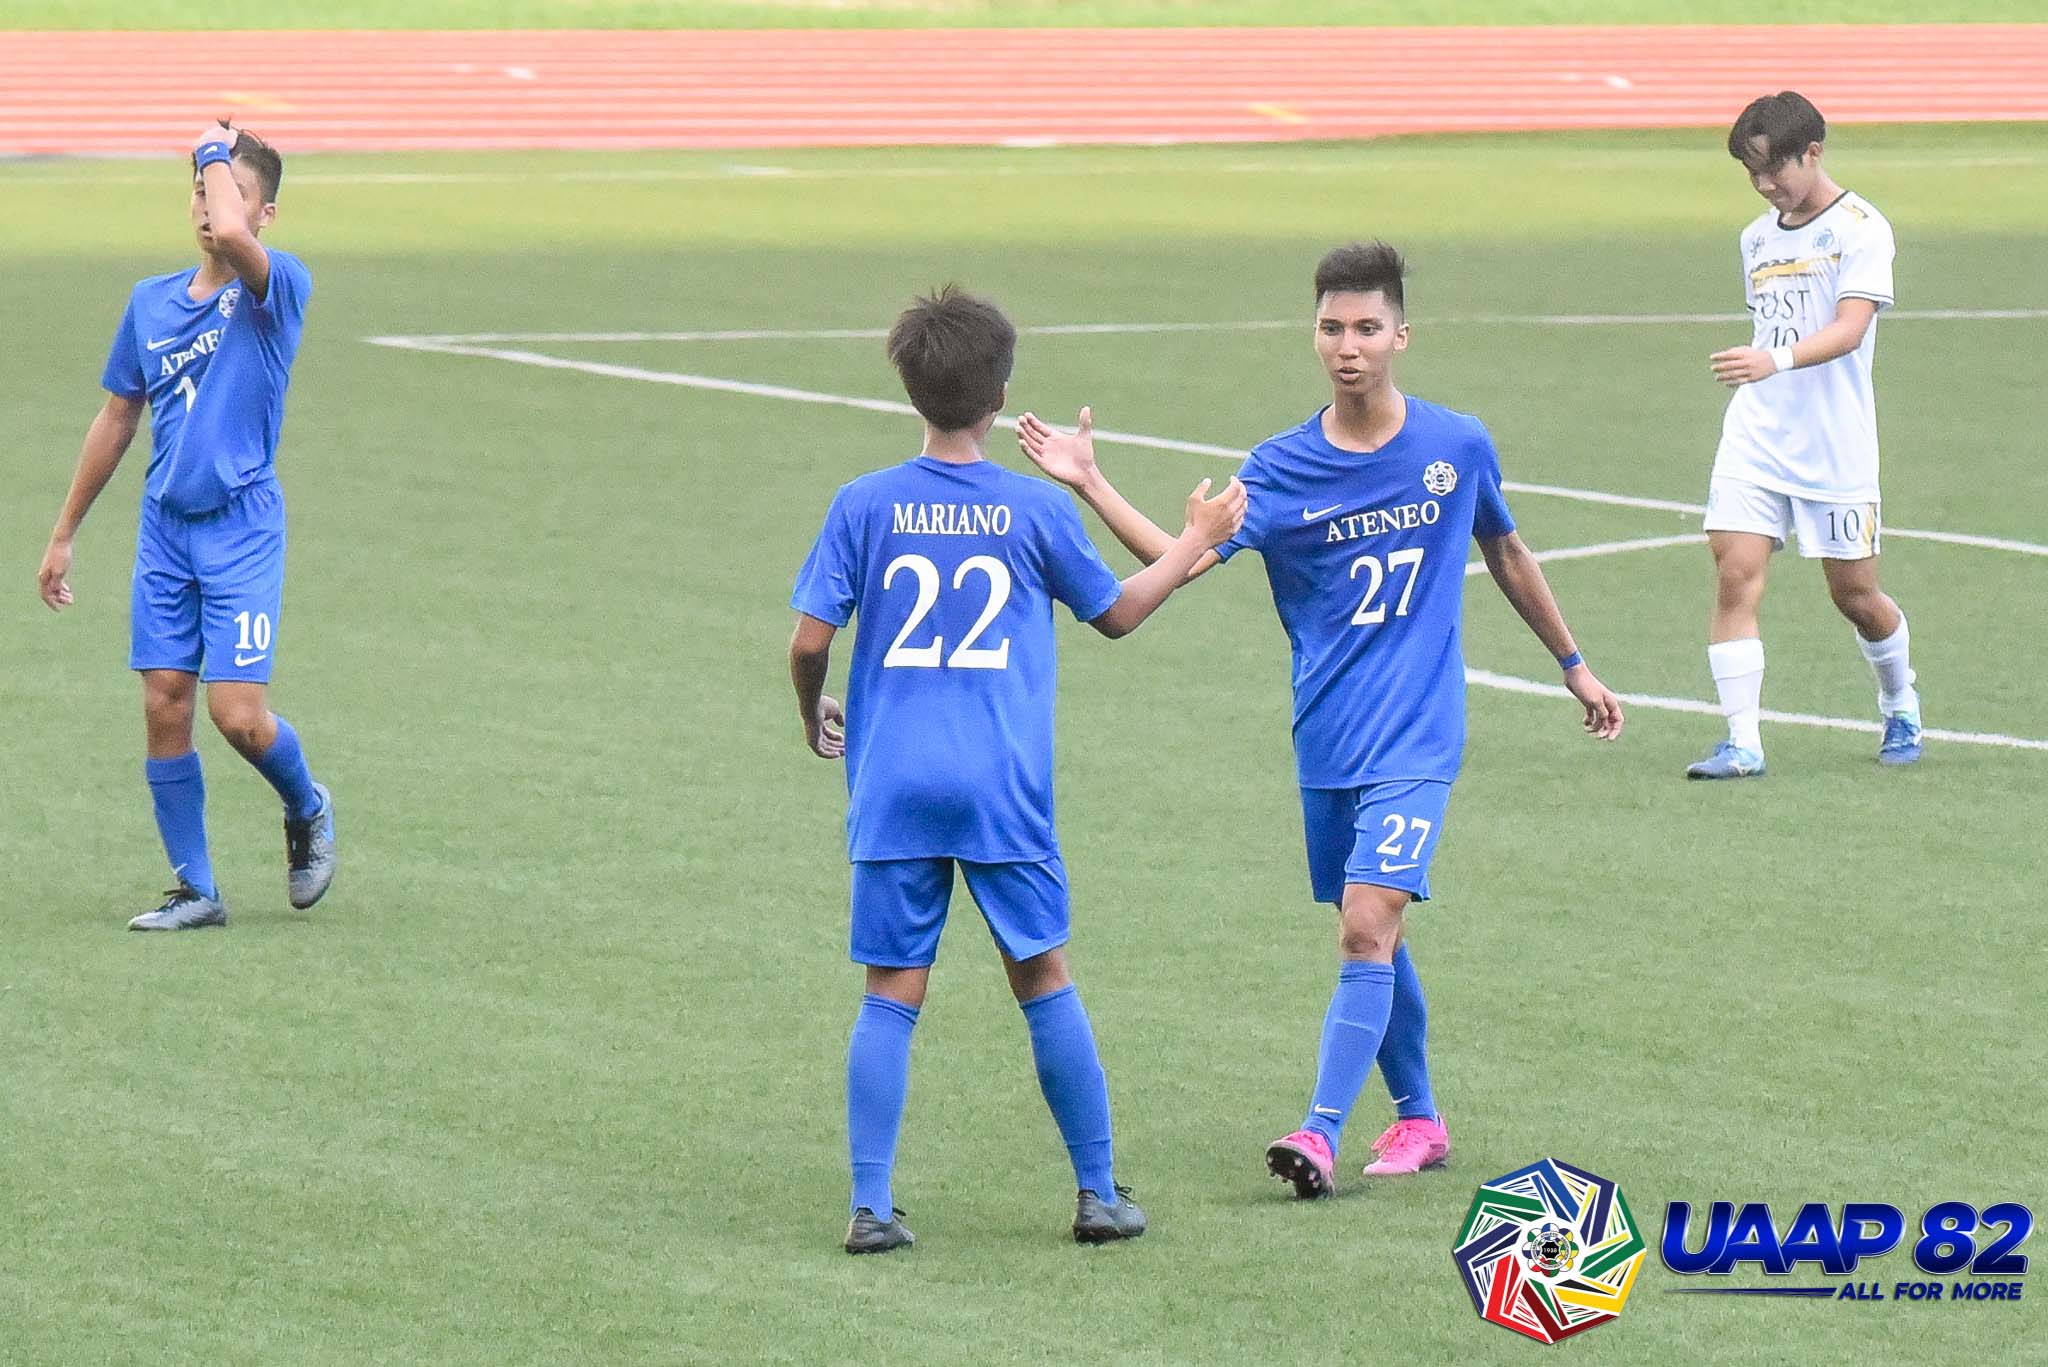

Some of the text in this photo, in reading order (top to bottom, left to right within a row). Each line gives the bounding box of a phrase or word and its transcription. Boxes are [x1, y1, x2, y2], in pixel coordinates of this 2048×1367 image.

[892, 502, 1011, 536] MARIANO
[1326, 500, 1441, 543] ATENEO
[1826, 509, 1860, 542] 10
[1350, 547, 1425, 626] 27
[233, 610, 271, 651] 10
[883, 554, 1012, 669] 22
[1375, 813, 1432, 861] 27
